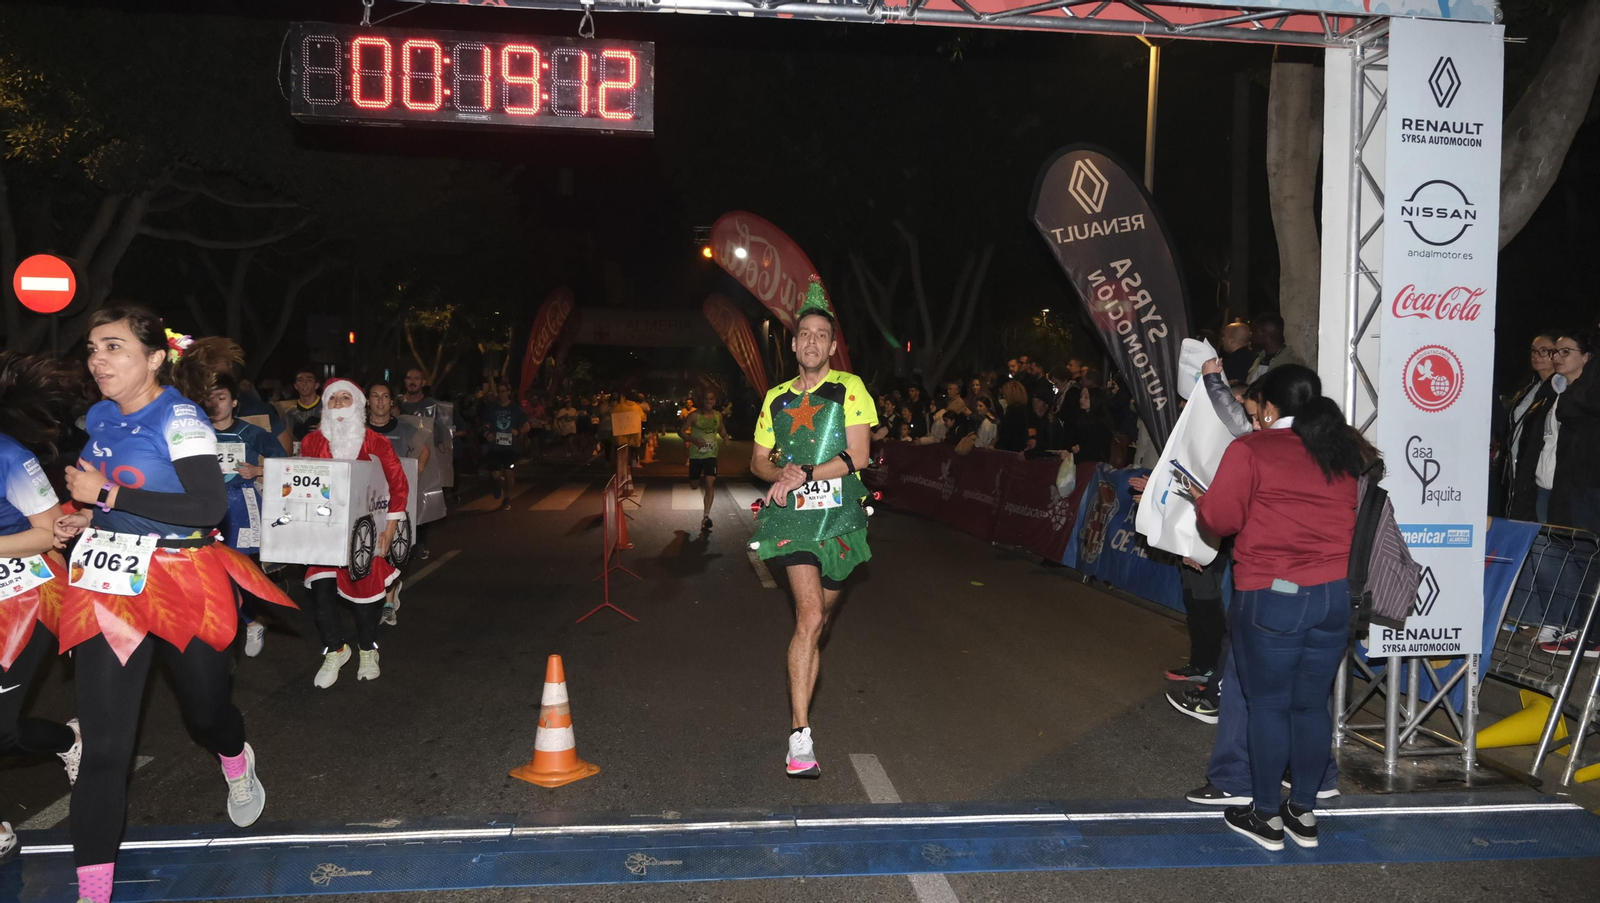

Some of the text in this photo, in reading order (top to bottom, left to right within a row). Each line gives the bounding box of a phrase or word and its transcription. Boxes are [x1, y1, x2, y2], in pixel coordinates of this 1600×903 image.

[351, 36, 637, 120] 00:19:12
[1401, 118, 1484, 135] RENAULT
[1401, 133, 1482, 147] SYRSA AUTOMOCION
[1401, 205, 1477, 220] NISSAN
[1407, 249, 1473, 261] andalmotor.es
[1392, 284, 1488, 321] Coca-Cola
[292, 475, 321, 488] 904
[803, 480, 831, 495] 340
[1400, 528, 1446, 544] mericar
[82, 549, 139, 575] 1062
[1382, 628, 1462, 641] RENAULT
[1382, 642, 1461, 653] SYRSA AUTOMOCION
